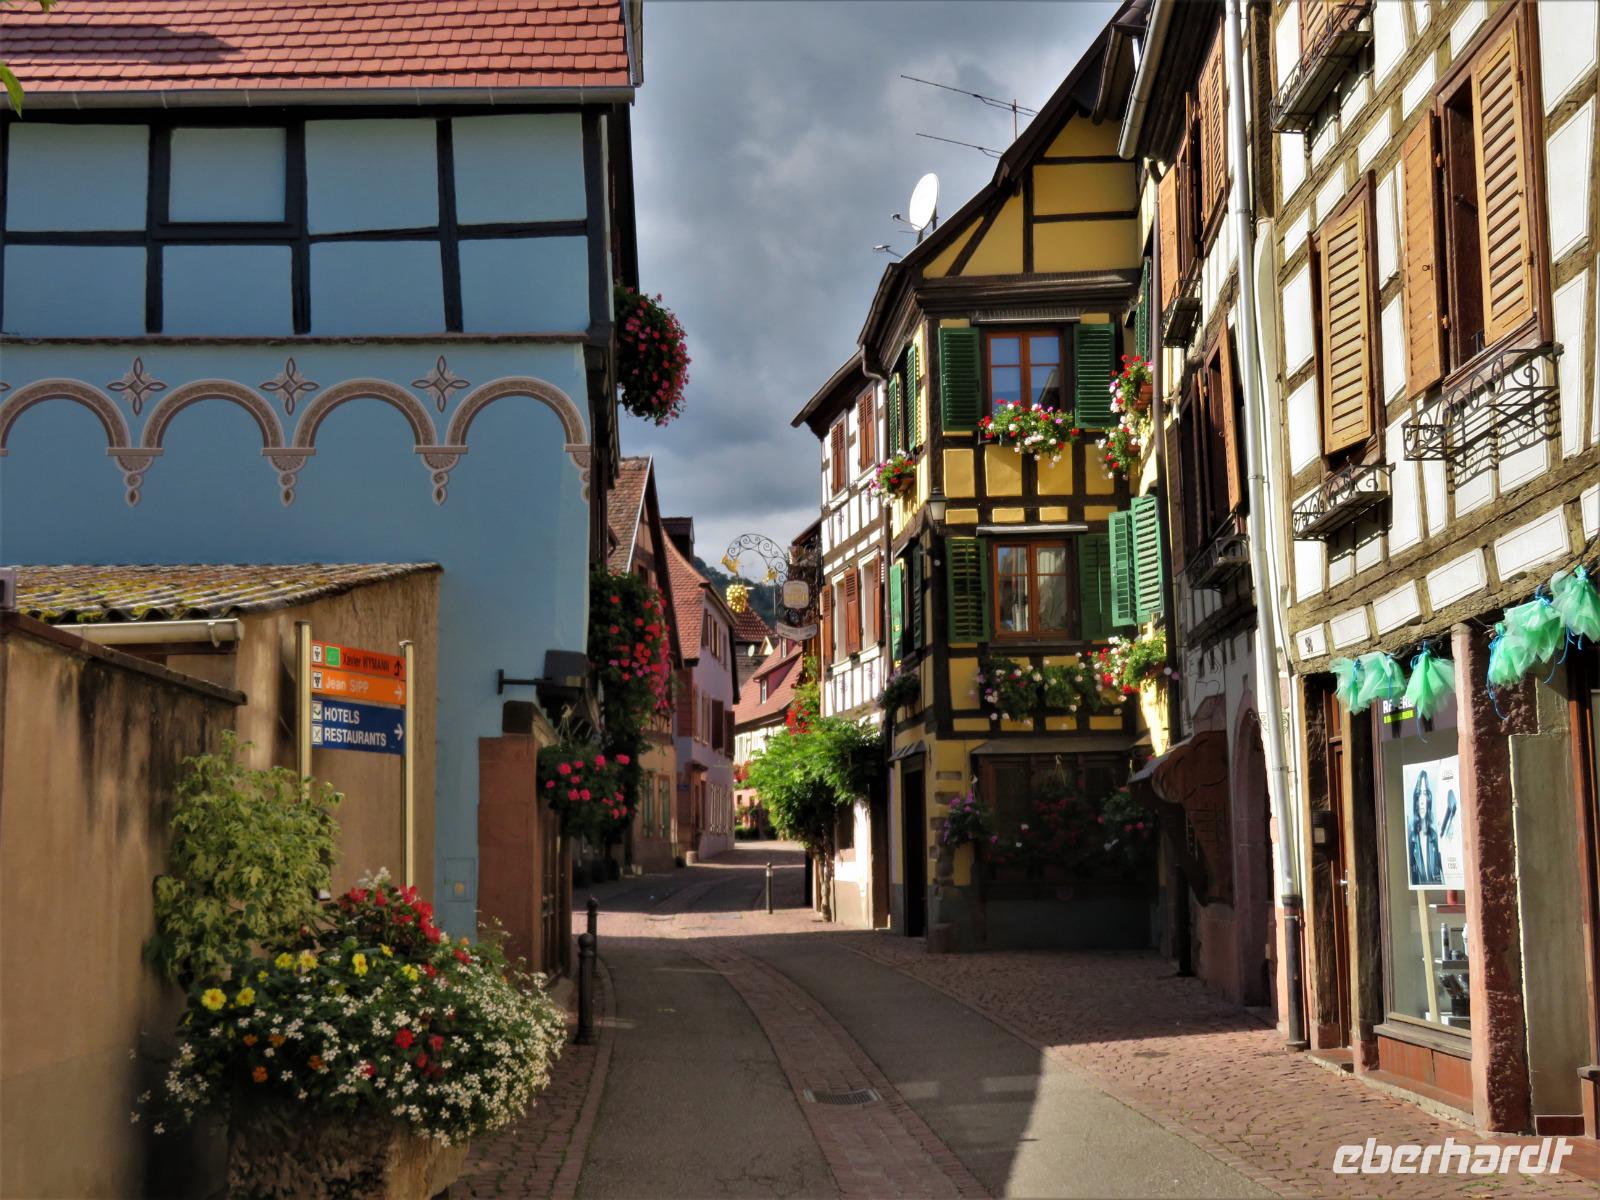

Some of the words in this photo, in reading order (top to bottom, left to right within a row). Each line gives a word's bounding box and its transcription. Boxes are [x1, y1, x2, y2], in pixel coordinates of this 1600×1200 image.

[326, 675, 346, 690] Jean
[324, 707, 360, 725] HOTELS
[324, 727, 387, 747] RESTAURANTS
